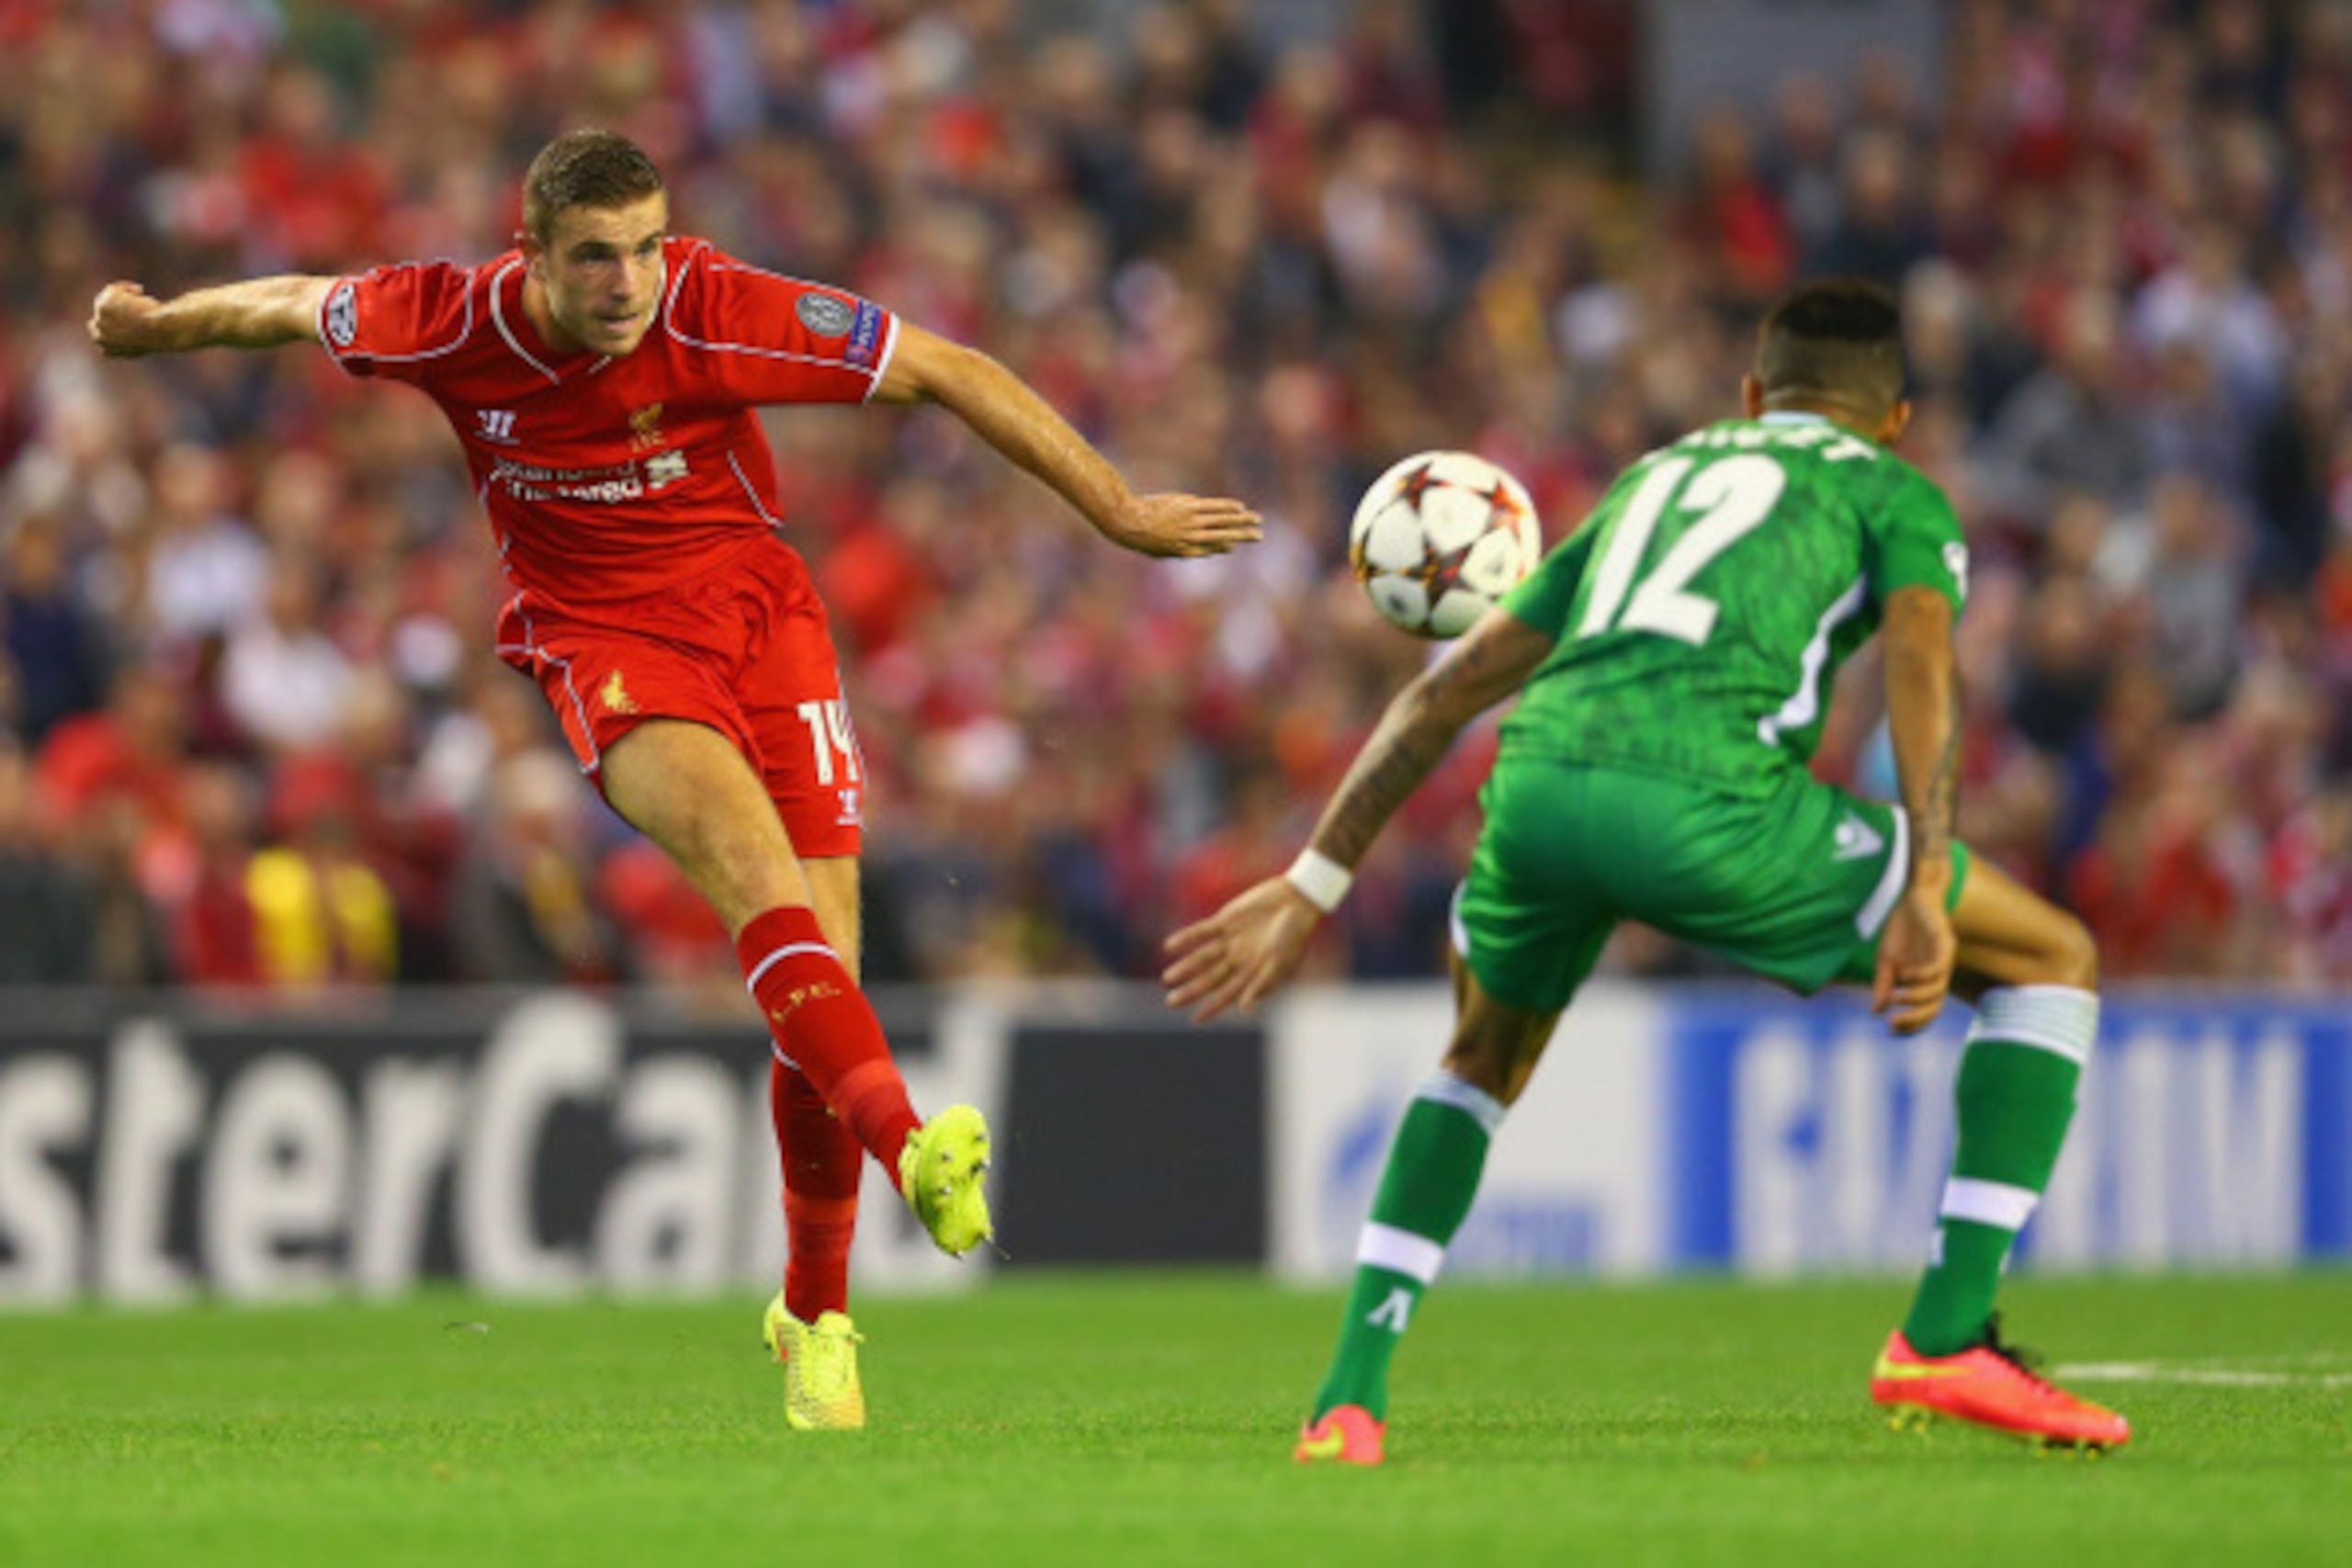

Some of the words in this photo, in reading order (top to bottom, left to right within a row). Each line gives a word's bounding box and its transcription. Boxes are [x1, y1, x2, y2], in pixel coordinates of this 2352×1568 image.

[1575, 454, 1786, 647] 12
[797, 699, 860, 785] 14
[0, 992, 1011, 1303] sterCad
